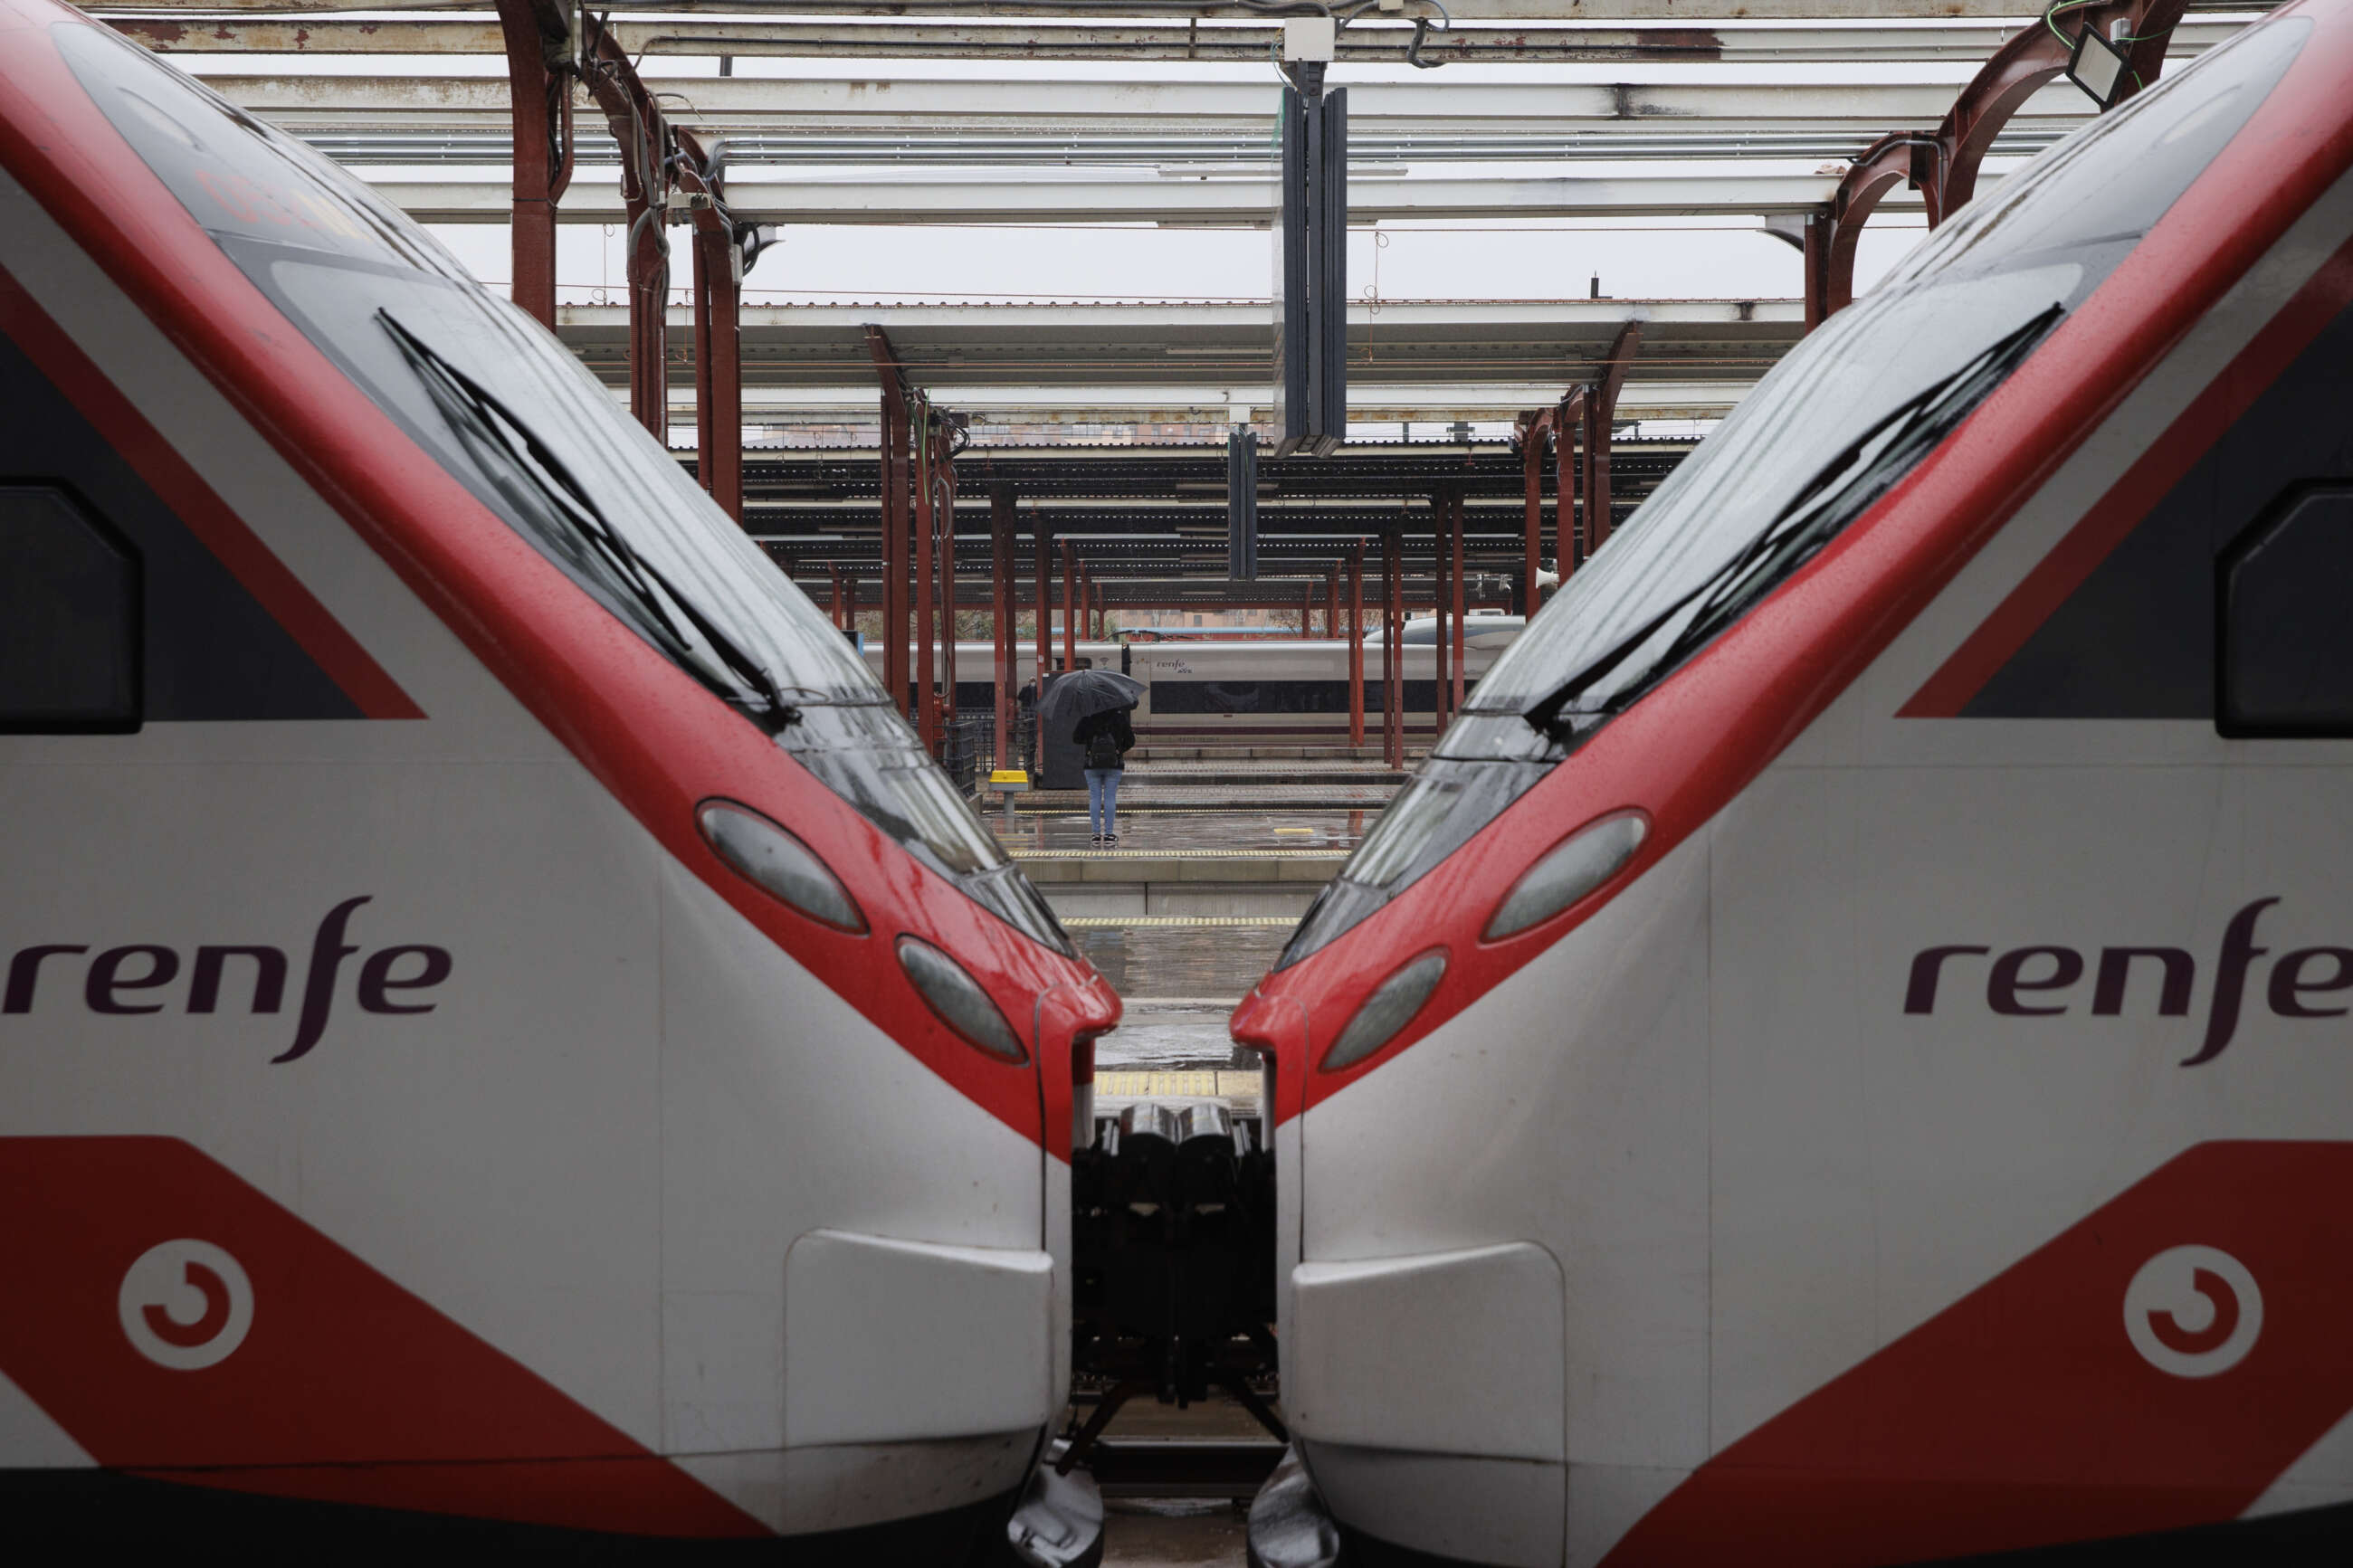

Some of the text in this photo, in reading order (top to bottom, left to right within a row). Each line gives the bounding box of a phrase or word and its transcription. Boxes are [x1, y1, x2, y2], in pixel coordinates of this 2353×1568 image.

[1157, 659, 1186, 670] renfe
[2, 895, 453, 1065] renfe
[1903, 896, 2353, 1068] renfe
